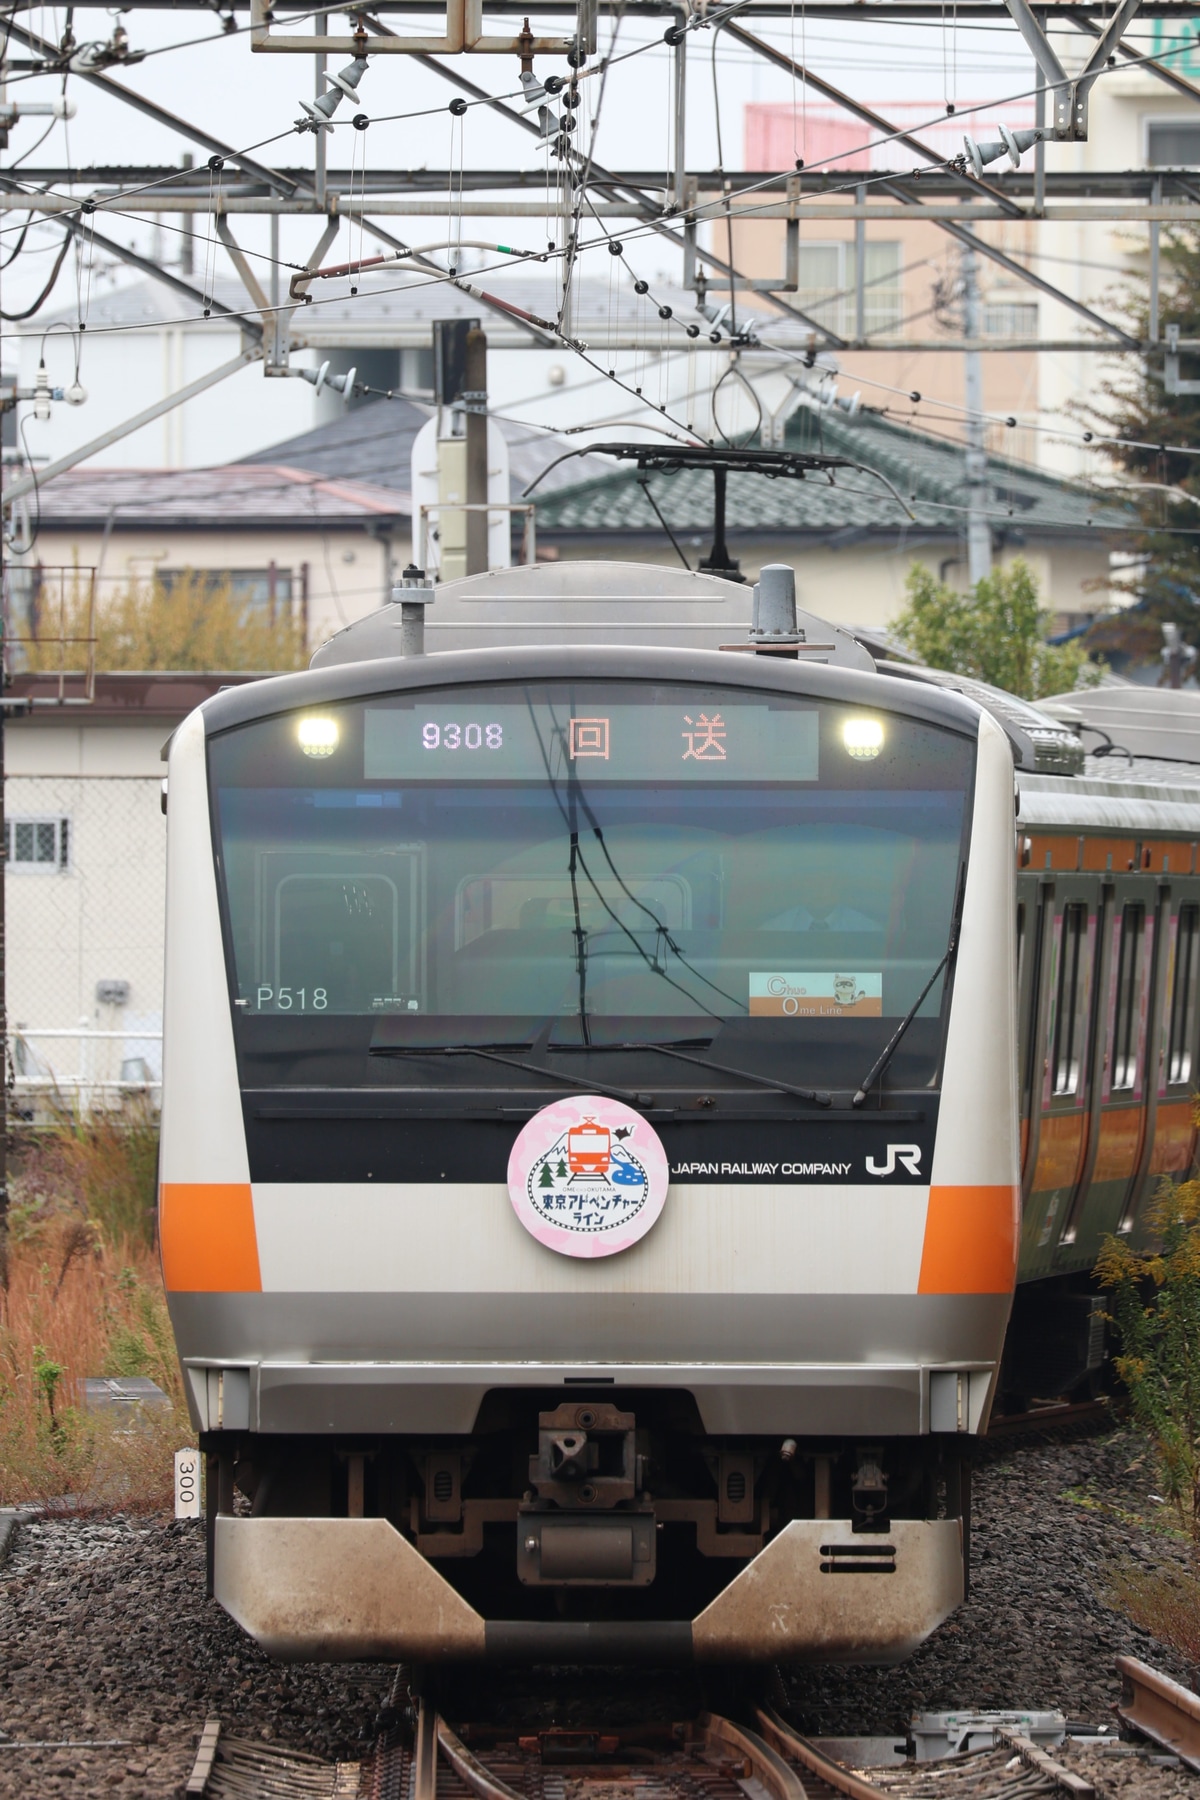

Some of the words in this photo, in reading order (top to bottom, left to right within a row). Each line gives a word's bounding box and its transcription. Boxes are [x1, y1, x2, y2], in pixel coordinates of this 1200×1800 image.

[422, 723, 504, 750] 9308
[569, 714, 727, 760] 回送
[767, 976, 807, 996] Chuo
[257, 988, 328, 1010] P518
[782, 997, 816, 1015] Ome
[820, 1006, 843, 1015] Line
[672, 1163, 719, 1175] JAPAN
[721, 1163, 779, 1175] RAILWAY
[781, 1163, 852, 1175] COMPANY
[865, 1144, 922, 1176] JR
[542, 1194, 639, 1210] 東京アドベンチャー
[573, 1212, 605, 1226] ライン
[180, 1462, 194, 1502] 300
